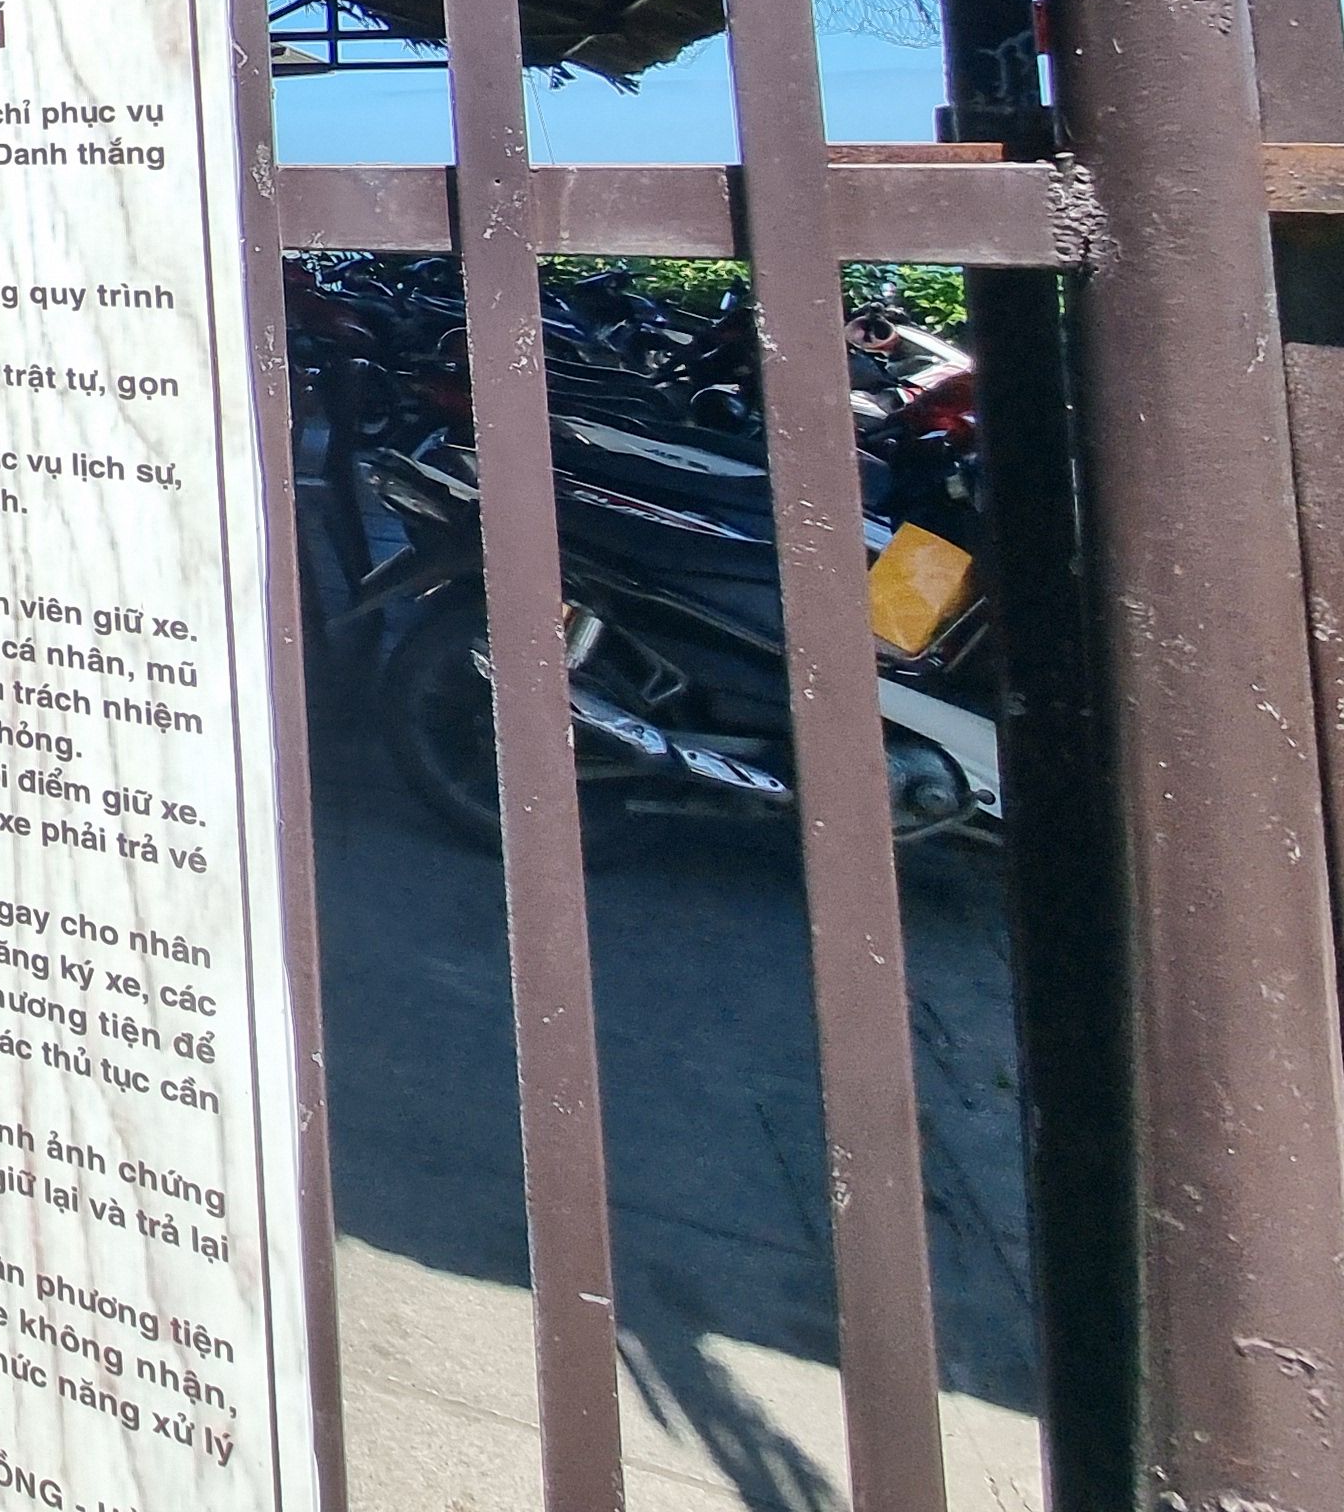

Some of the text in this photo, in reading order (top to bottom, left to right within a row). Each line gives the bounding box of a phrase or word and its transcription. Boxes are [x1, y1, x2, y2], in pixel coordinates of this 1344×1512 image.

[41, 101, 115, 130] phục
[125, 104, 163, 127] vụ
[76, 136, 165, 170] thắng
[29, 285, 86, 311] quy
[96, 282, 173, 309] trình
[15, 596, 82, 625] viên
[93, 606, 143, 635] giữ
[151, 617, 197, 642] xe.
[60, 912, 118, 945] cho
[129, 929, 210, 969] nhân
[36, 1273, 159, 1341] phương
[169, 1317, 233, 1363] tiện
[58, 1375, 140, 1431] năng
[151, 1411, 195, 1446] xử
[204, 1426, 233, 1467] lý
